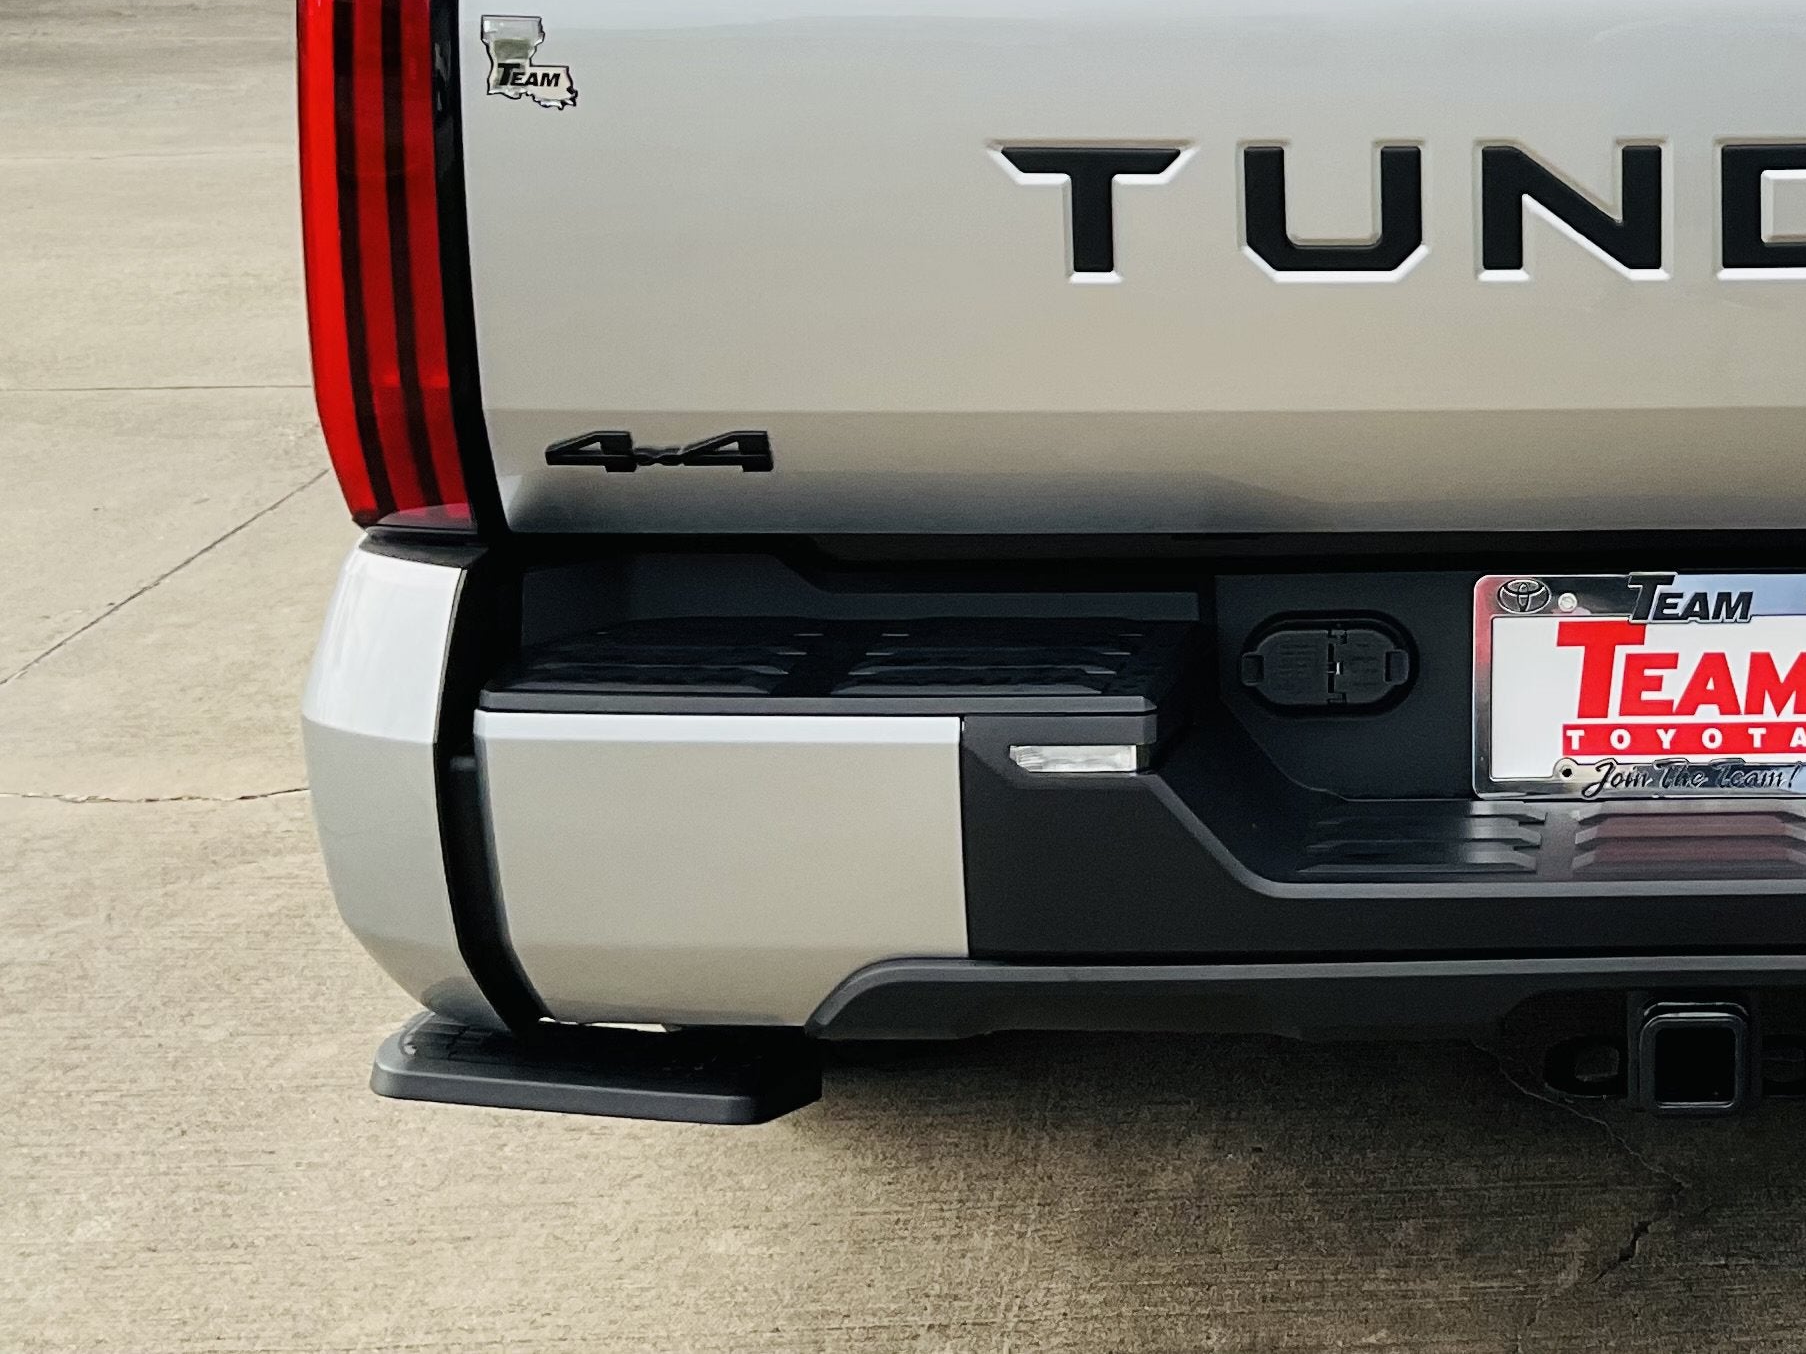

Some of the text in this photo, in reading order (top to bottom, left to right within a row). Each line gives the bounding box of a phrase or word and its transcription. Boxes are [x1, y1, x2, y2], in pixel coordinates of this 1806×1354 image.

[497, 62, 561, 87] TEAM
[1628, 573, 1753, 623] TEAM
[1581, 758, 1801, 797] Join The Team!
